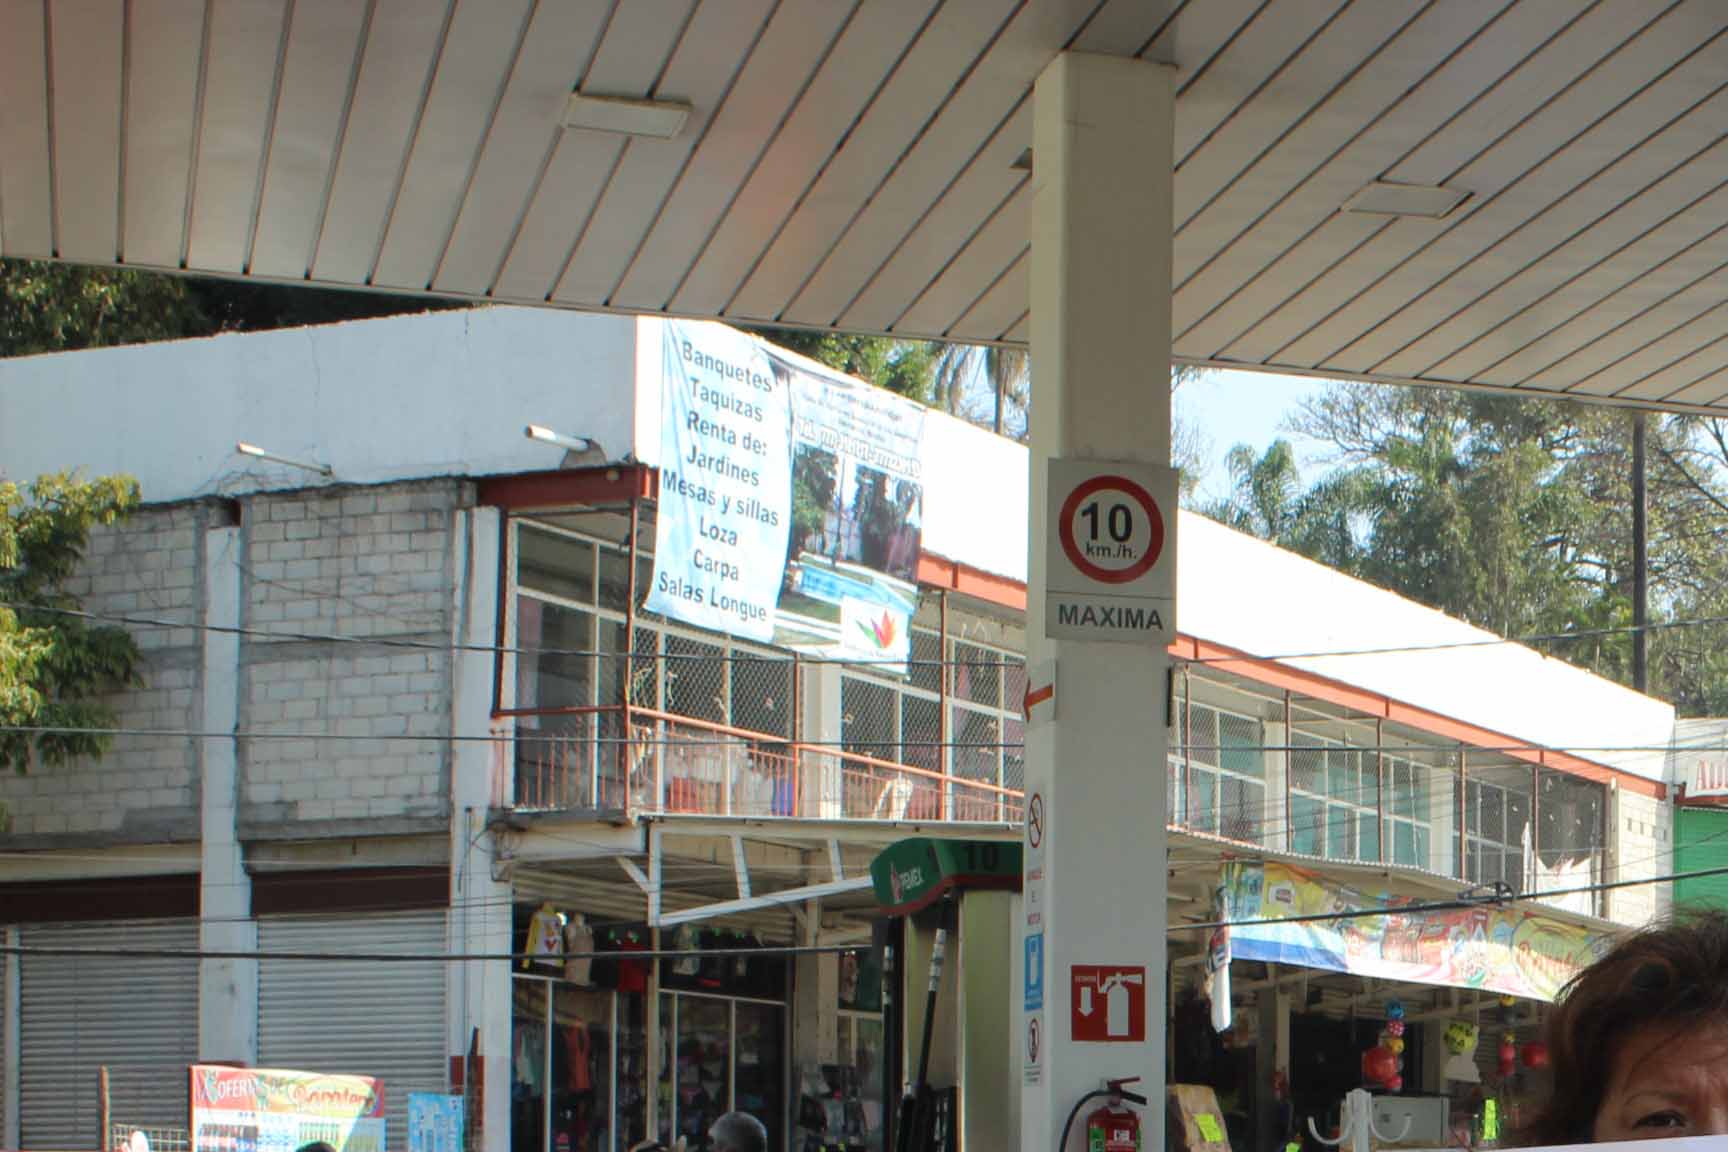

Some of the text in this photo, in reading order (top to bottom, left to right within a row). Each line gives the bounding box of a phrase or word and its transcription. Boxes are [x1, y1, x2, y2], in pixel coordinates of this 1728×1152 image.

[682, 341, 772, 393] Banquetes
[690, 377, 763, 421] Taquizas
[687, 411, 737, 445] Renta
[743, 430, 768, 456] de:
[686, 445, 760, 486] Jardines
[662, 468, 779, 527] Mesas y sillas
[699, 516, 738, 546] Loza
[1080, 503, 1133, 543] 10
[693, 549, 740, 582] Carpa
[659, 571, 767, 622] Salas Longue
[1058, 604, 1164, 631] MAXIMA
